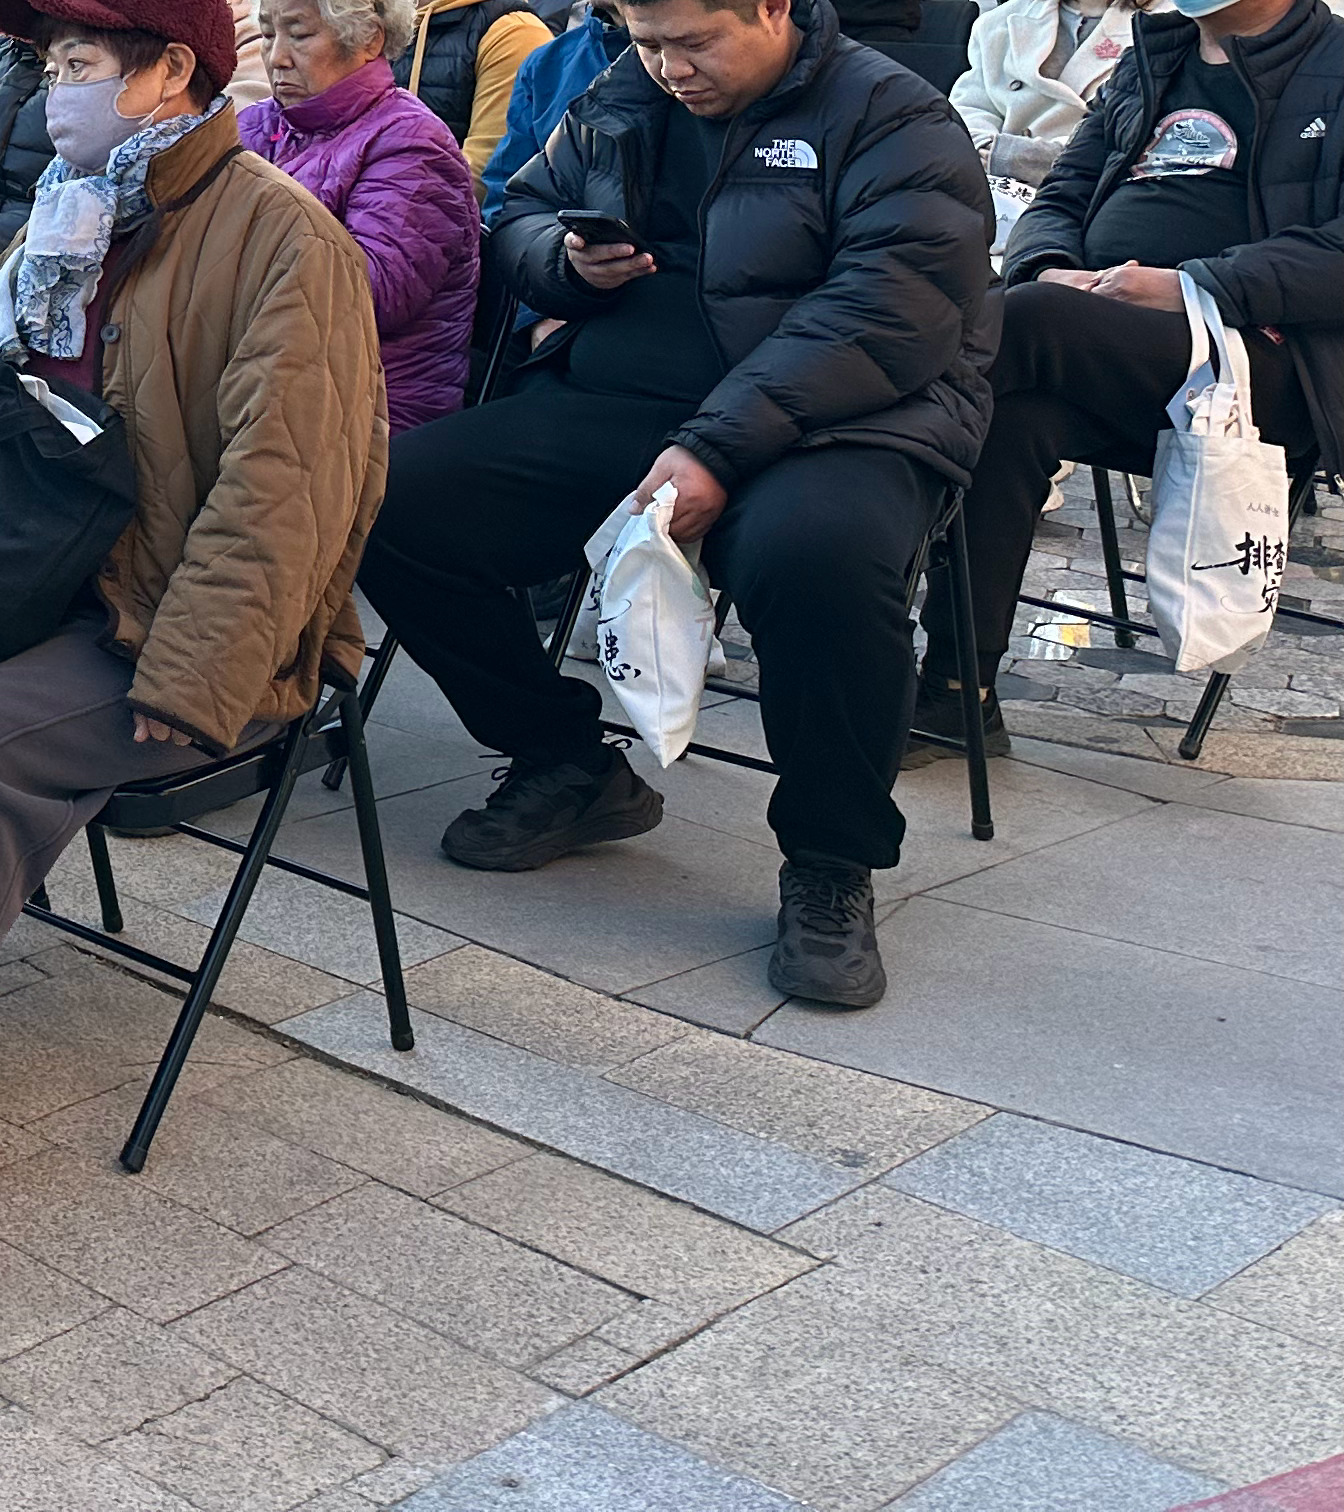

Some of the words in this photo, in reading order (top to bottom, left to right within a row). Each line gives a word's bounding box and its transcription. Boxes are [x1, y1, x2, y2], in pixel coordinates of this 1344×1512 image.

[772, 139, 795, 149] THE
[754, 148, 795, 158] NORTH
[765, 158, 795, 167] FACE
[1191, 531, 1286, 581] 排查
